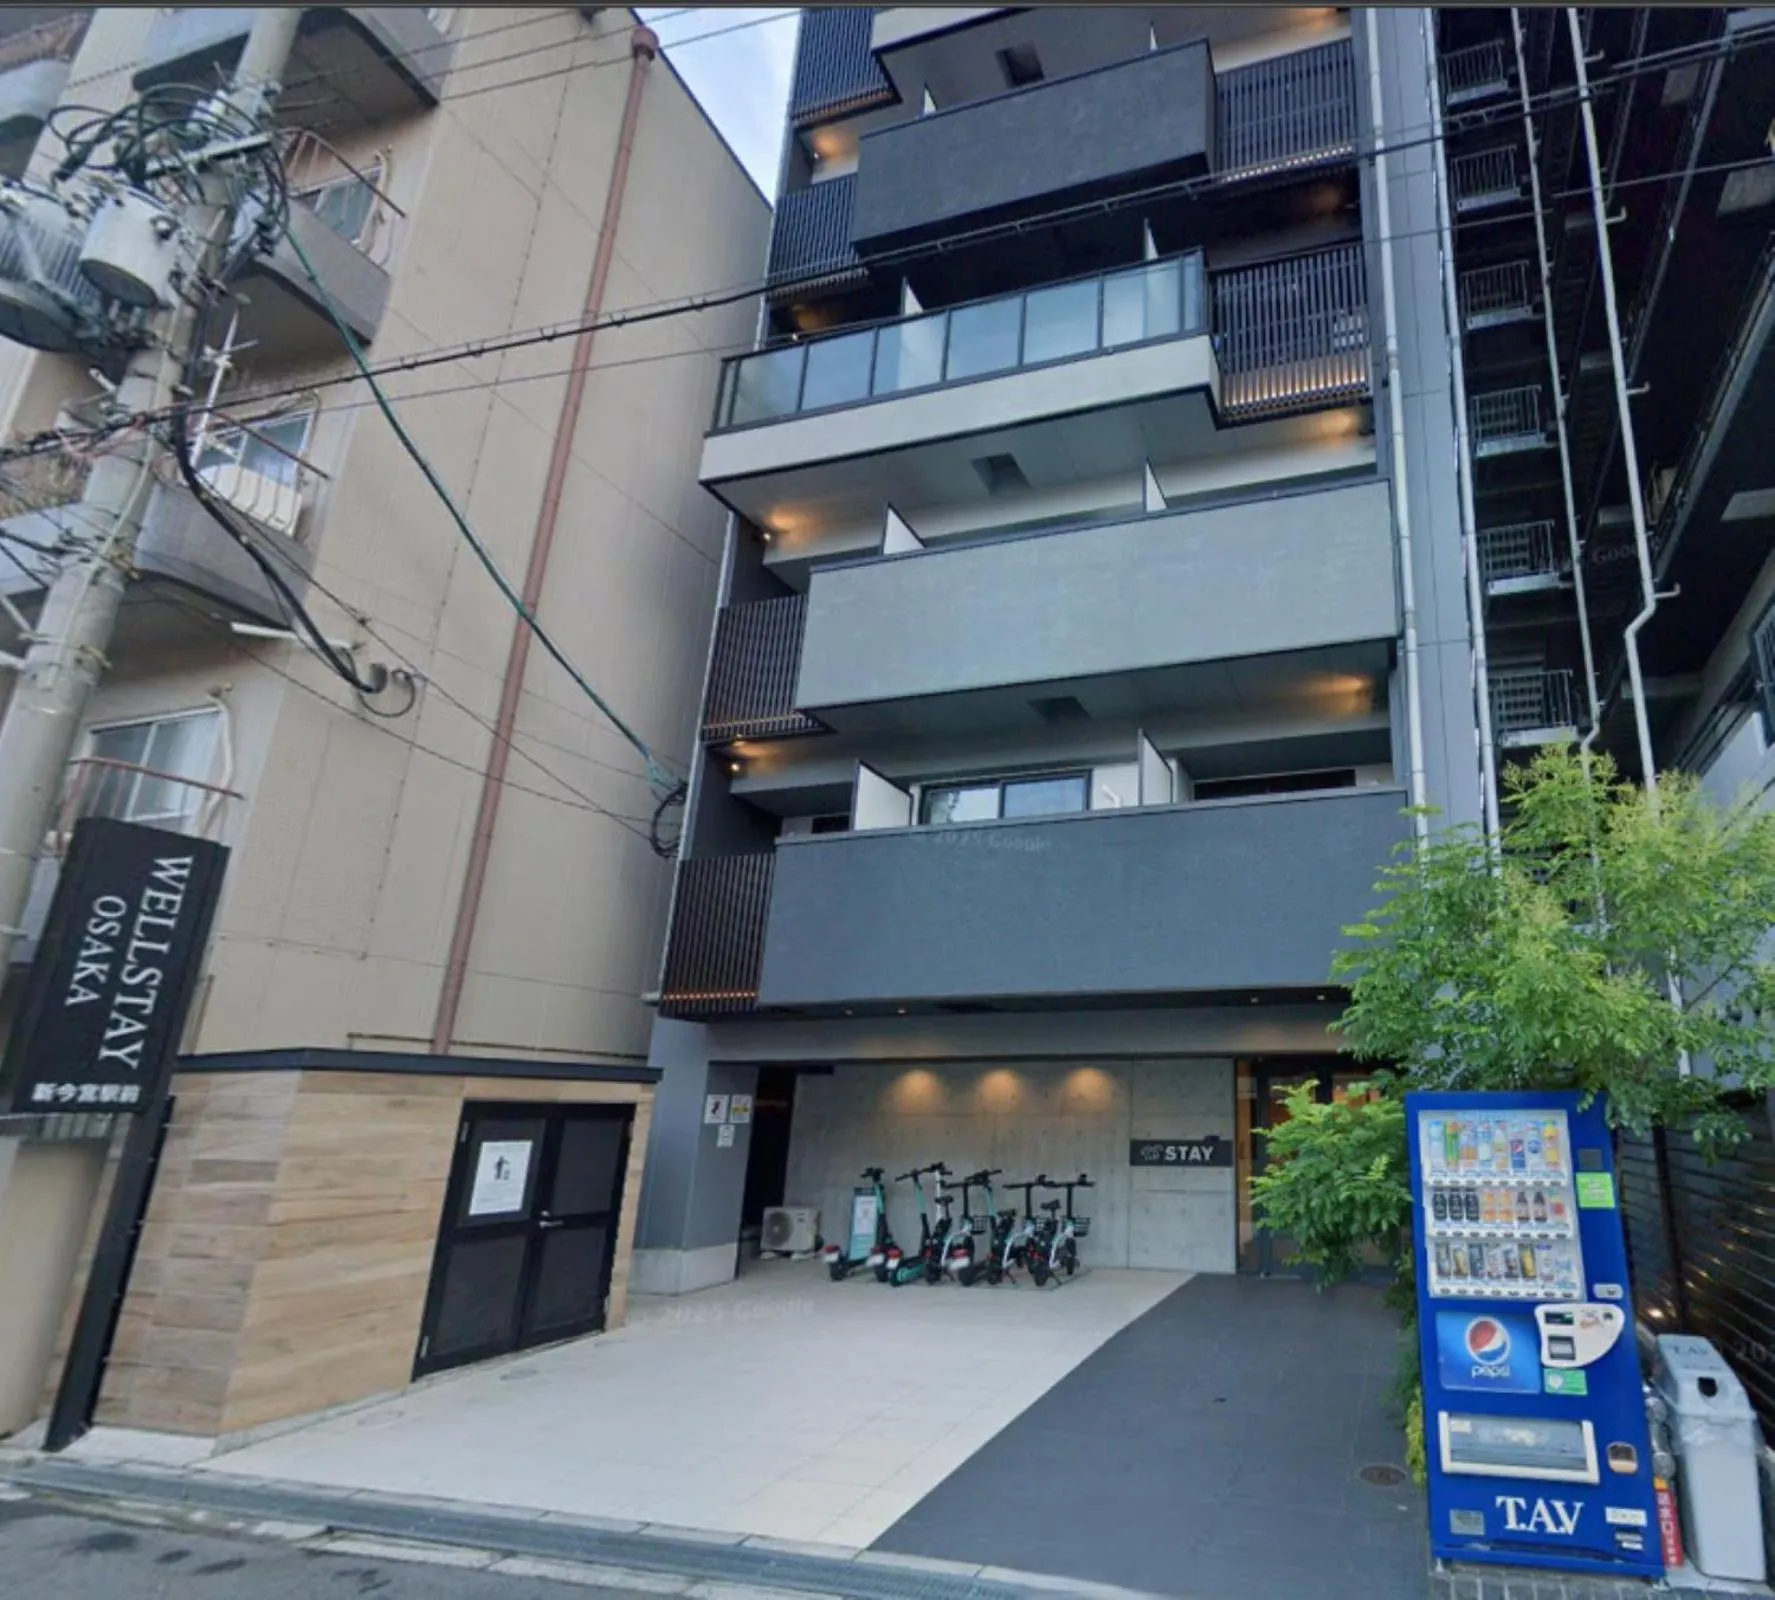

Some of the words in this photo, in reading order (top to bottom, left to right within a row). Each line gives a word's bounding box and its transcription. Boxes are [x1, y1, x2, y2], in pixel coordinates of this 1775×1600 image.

[64, 895, 127, 1007] OSAKA
[1165, 1145, 1214, 1161] STAY
[1471, 1364, 1511, 1380] pepsi
